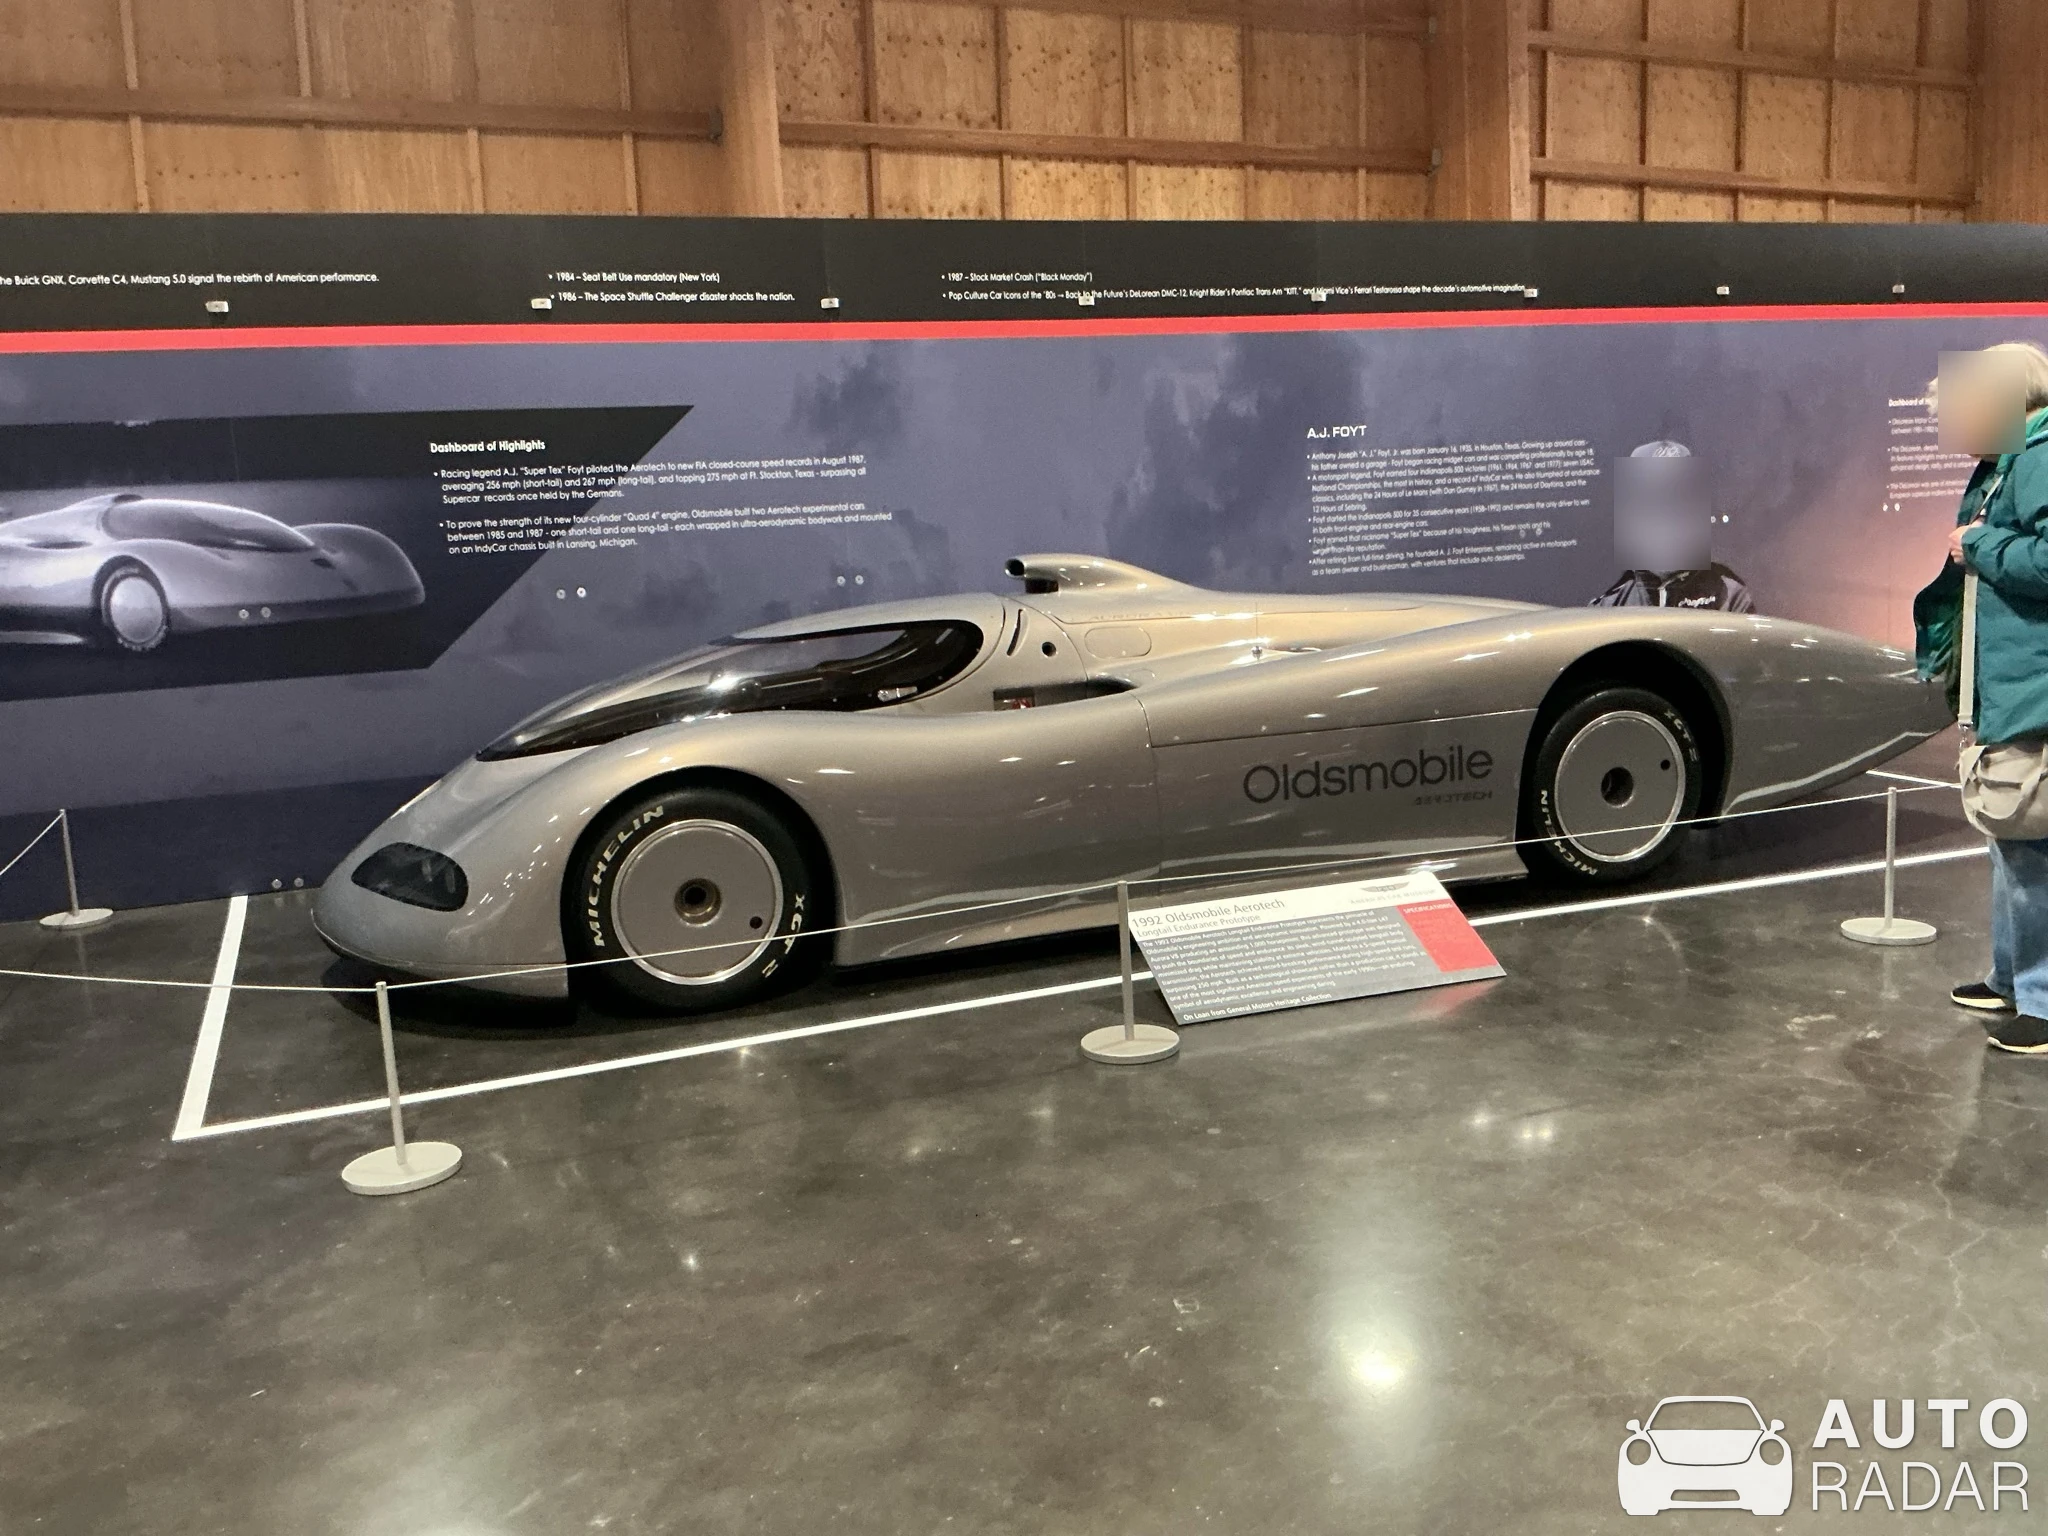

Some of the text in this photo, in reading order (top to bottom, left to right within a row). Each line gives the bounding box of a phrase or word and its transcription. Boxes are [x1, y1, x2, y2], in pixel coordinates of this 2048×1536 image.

[14, 275, 40, 285] Buick
[68, 274, 110, 284] Corvette
[130, 274, 170, 285] Mustang
[172, 274, 186, 283] 5.0
[188, 274, 214, 285] signal
[216, 273, 231, 282] the
[233, 273, 261, 282] rebirth
[275, 272, 318, 282] American
[320, 272, 379, 283] performance.
[556, 272, 719, 282] 1984 Seat Belt Use mandatory (New York)
[948, 272, 1092, 282] 1987 Stock Market Crash ("Black Monday")
[558, 292, 795, 302] 1986 The Space Shuttle Challenger disaster shocks the nation.
[948, 291, 962, 300] Pop
[964, 290, 988, 299] Culture
[989, 290, 1001, 299] Car
[1003, 291, 1021, 299] Icons
[1103, 289, 1128, 297] Future's
[1129, 289, 1160, 297] DeLorean
[1189, 288, 1208, 298] Knight
[1210, 288, 1230, 296] Rider's
[1231, 287, 1254, 295] Pontiac
[1255, 287, 1270, 295] Trans
[1302, 287, 1315, 295] and
[1335, 286, 1353, 294] Vice's
[1373, 285, 1402, 293] Testarossa
[1402, 285, 1420, 294] shape
[1432, 284, 1459, 292] decade's
[1460, 284, 1492, 292] automotive
[1307, 425, 1366, 439] A.J. FOYT
[430, 439, 545, 452] Dashboard of Highlights
[441, 456, 846, 480] Racing legend A.J. "Super Tex" Foyt piloted the Aerotech new FIA closed-course speed records August
[441, 481, 484, 492] averaging
[486, 480, 500, 489] 256
[502, 480, 520, 489] mph
[523, 478, 562, 489] (short-tail)
[564, 478, 580, 486] and
[582, 477, 595, 485] 267
[597, 477, 615, 486] mph
[658, 474, 674, 483] and
[675, 473, 705, 484] topping
[706, 472, 720, 481] 275
[721, 472, 738, 482] mph
[794, 468, 814, 477] Texas
[820, 467, 856, 478] surpassing
[442, 493, 480, 504] Supercar
[484, 492, 515, 502] records
[539, 491, 557, 499] held
[559, 491, 569, 500] by
[571, 490, 584, 498] the
[586, 488, 624, 498] Germans.
[445, 520, 456, 528] To
[458, 520, 481, 529] prove
[484, 518, 497, 527] the
[499, 517, 532, 528] strength
[573, 513, 621, 524] four-cylinder
[623, 511, 649, 522] "Quad
[691, 507, 732, 518] Oldsmobile
[734, 507, 750, 516] built
[751, 507, 765, 515] two
[766, 505, 800, 514] Aerotech
[802, 503, 848, 514] experimental
[447, 532, 484, 541] between
[486, 530, 505, 539] 1985
[506, 530, 523, 538] and
[525, 528, 543, 537] 1987
[568, 526, 601, 536] short-tail
[603, 525, 618, 534] and
[637, 523, 668, 534] long-tail
[674, 522, 694, 531] each
[696, 520, 730, 531] wrapped
[740, 516, 806, 529] ultra-aerodynamic
[807, 515, 842, 526] bodywork
[844, 514, 858, 522] and
[860, 512, 892, 521] mounted
[474, 542, 506, 554] IndyCar
[508, 542, 536, 551] chassis
[538, 541, 555, 549] built
[599, 537, 637, 548] Michigan.
[1243, 745, 1493, 804] Oldsmobile
[587, 805, 664, 947] MICHELIN
[1132, 899, 1284, 928] 1992 Oldsmobile Aerotech
[1137, 914, 1260, 937] Longtail Endurance Prototype
[1194, 1010, 1209, 1019] Loan
[1210, 1008, 1225, 1016] from
[1226, 1004, 1250, 1014] General
[1251, 1000, 1273, 1010] Motors
[1274, 996, 1300, 1008] Heritage
[1301, 992, 1331, 1002] Collection
